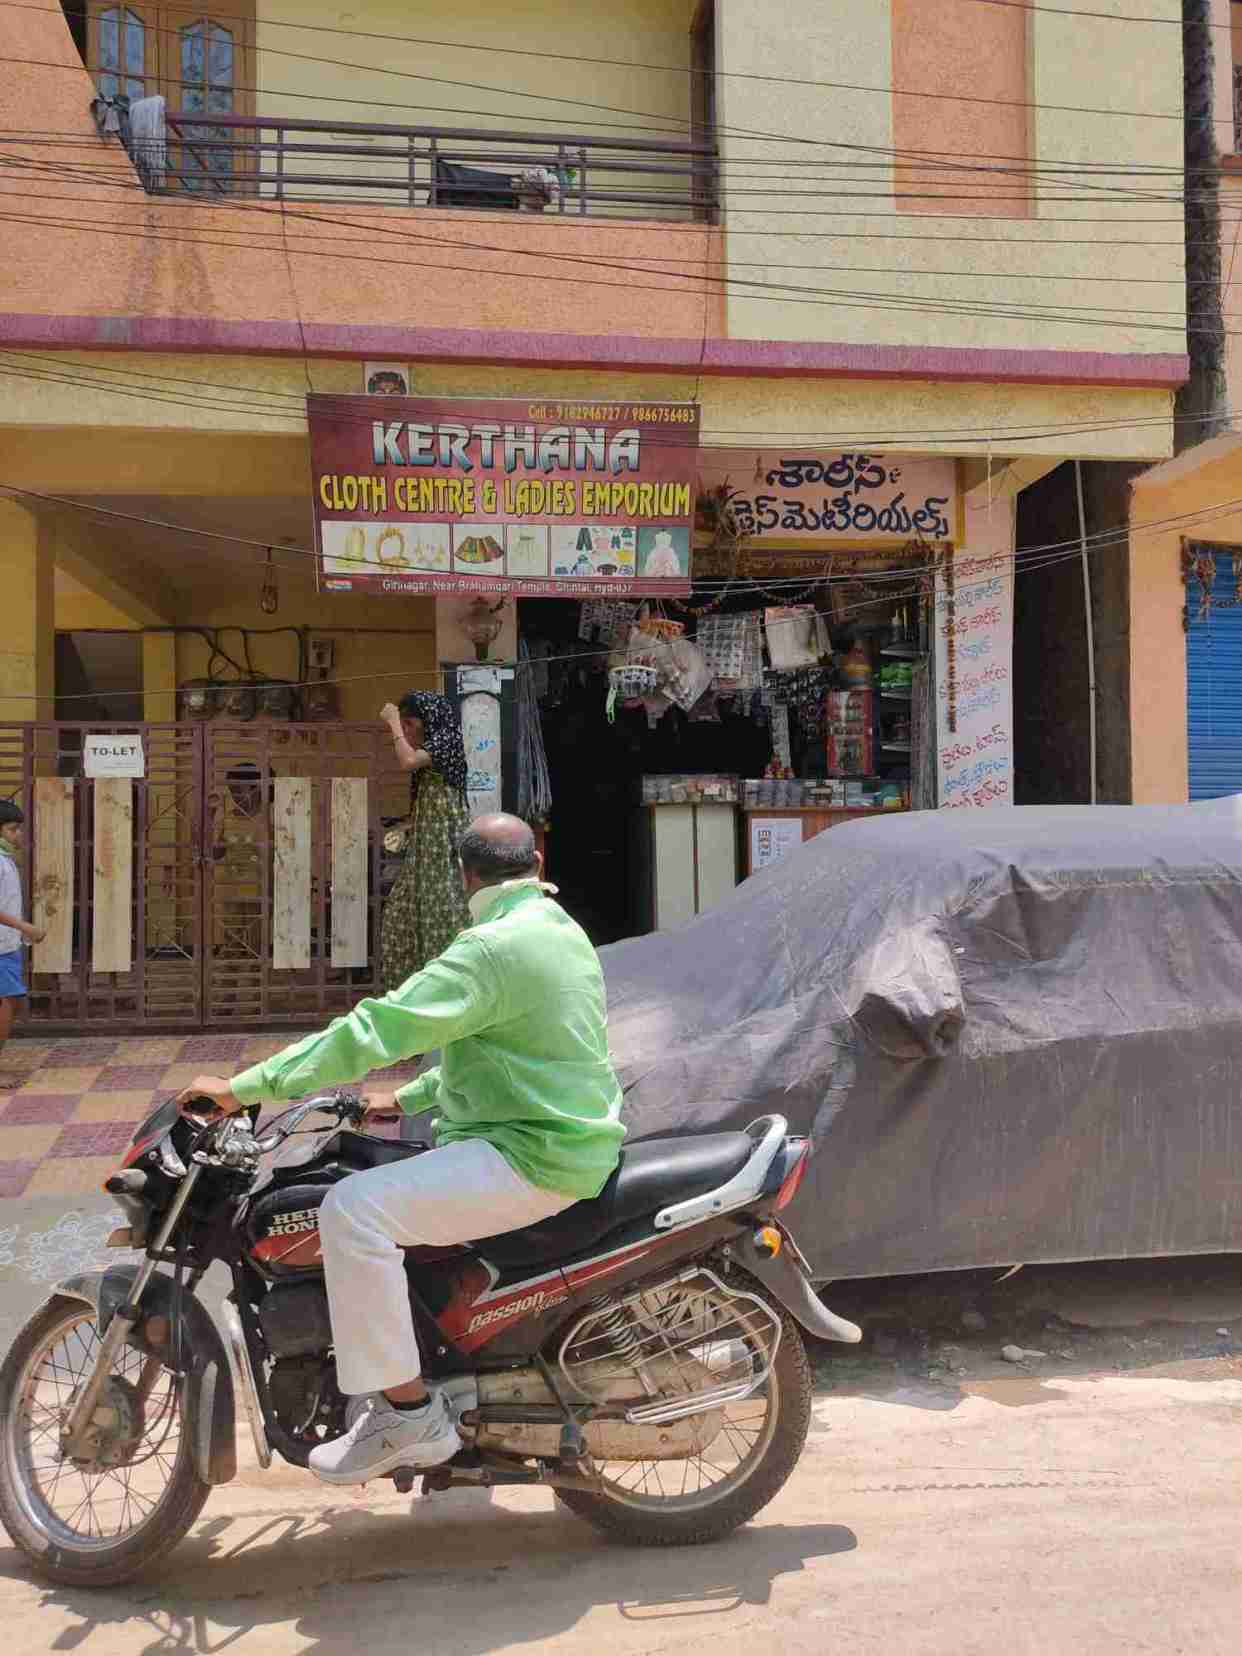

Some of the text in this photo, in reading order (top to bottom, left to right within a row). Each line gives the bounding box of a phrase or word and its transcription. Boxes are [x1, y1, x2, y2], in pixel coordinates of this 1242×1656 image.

[371, 420, 642, 473] KERTHANA
[319, 474, 388, 515] CLOTH
[393, 477, 476, 517] CENTRE
[503, 479, 577, 517] LADIES
[581, 480, 691, 520] EMPORIUM
[89, 746, 137, 756] TO-LET
